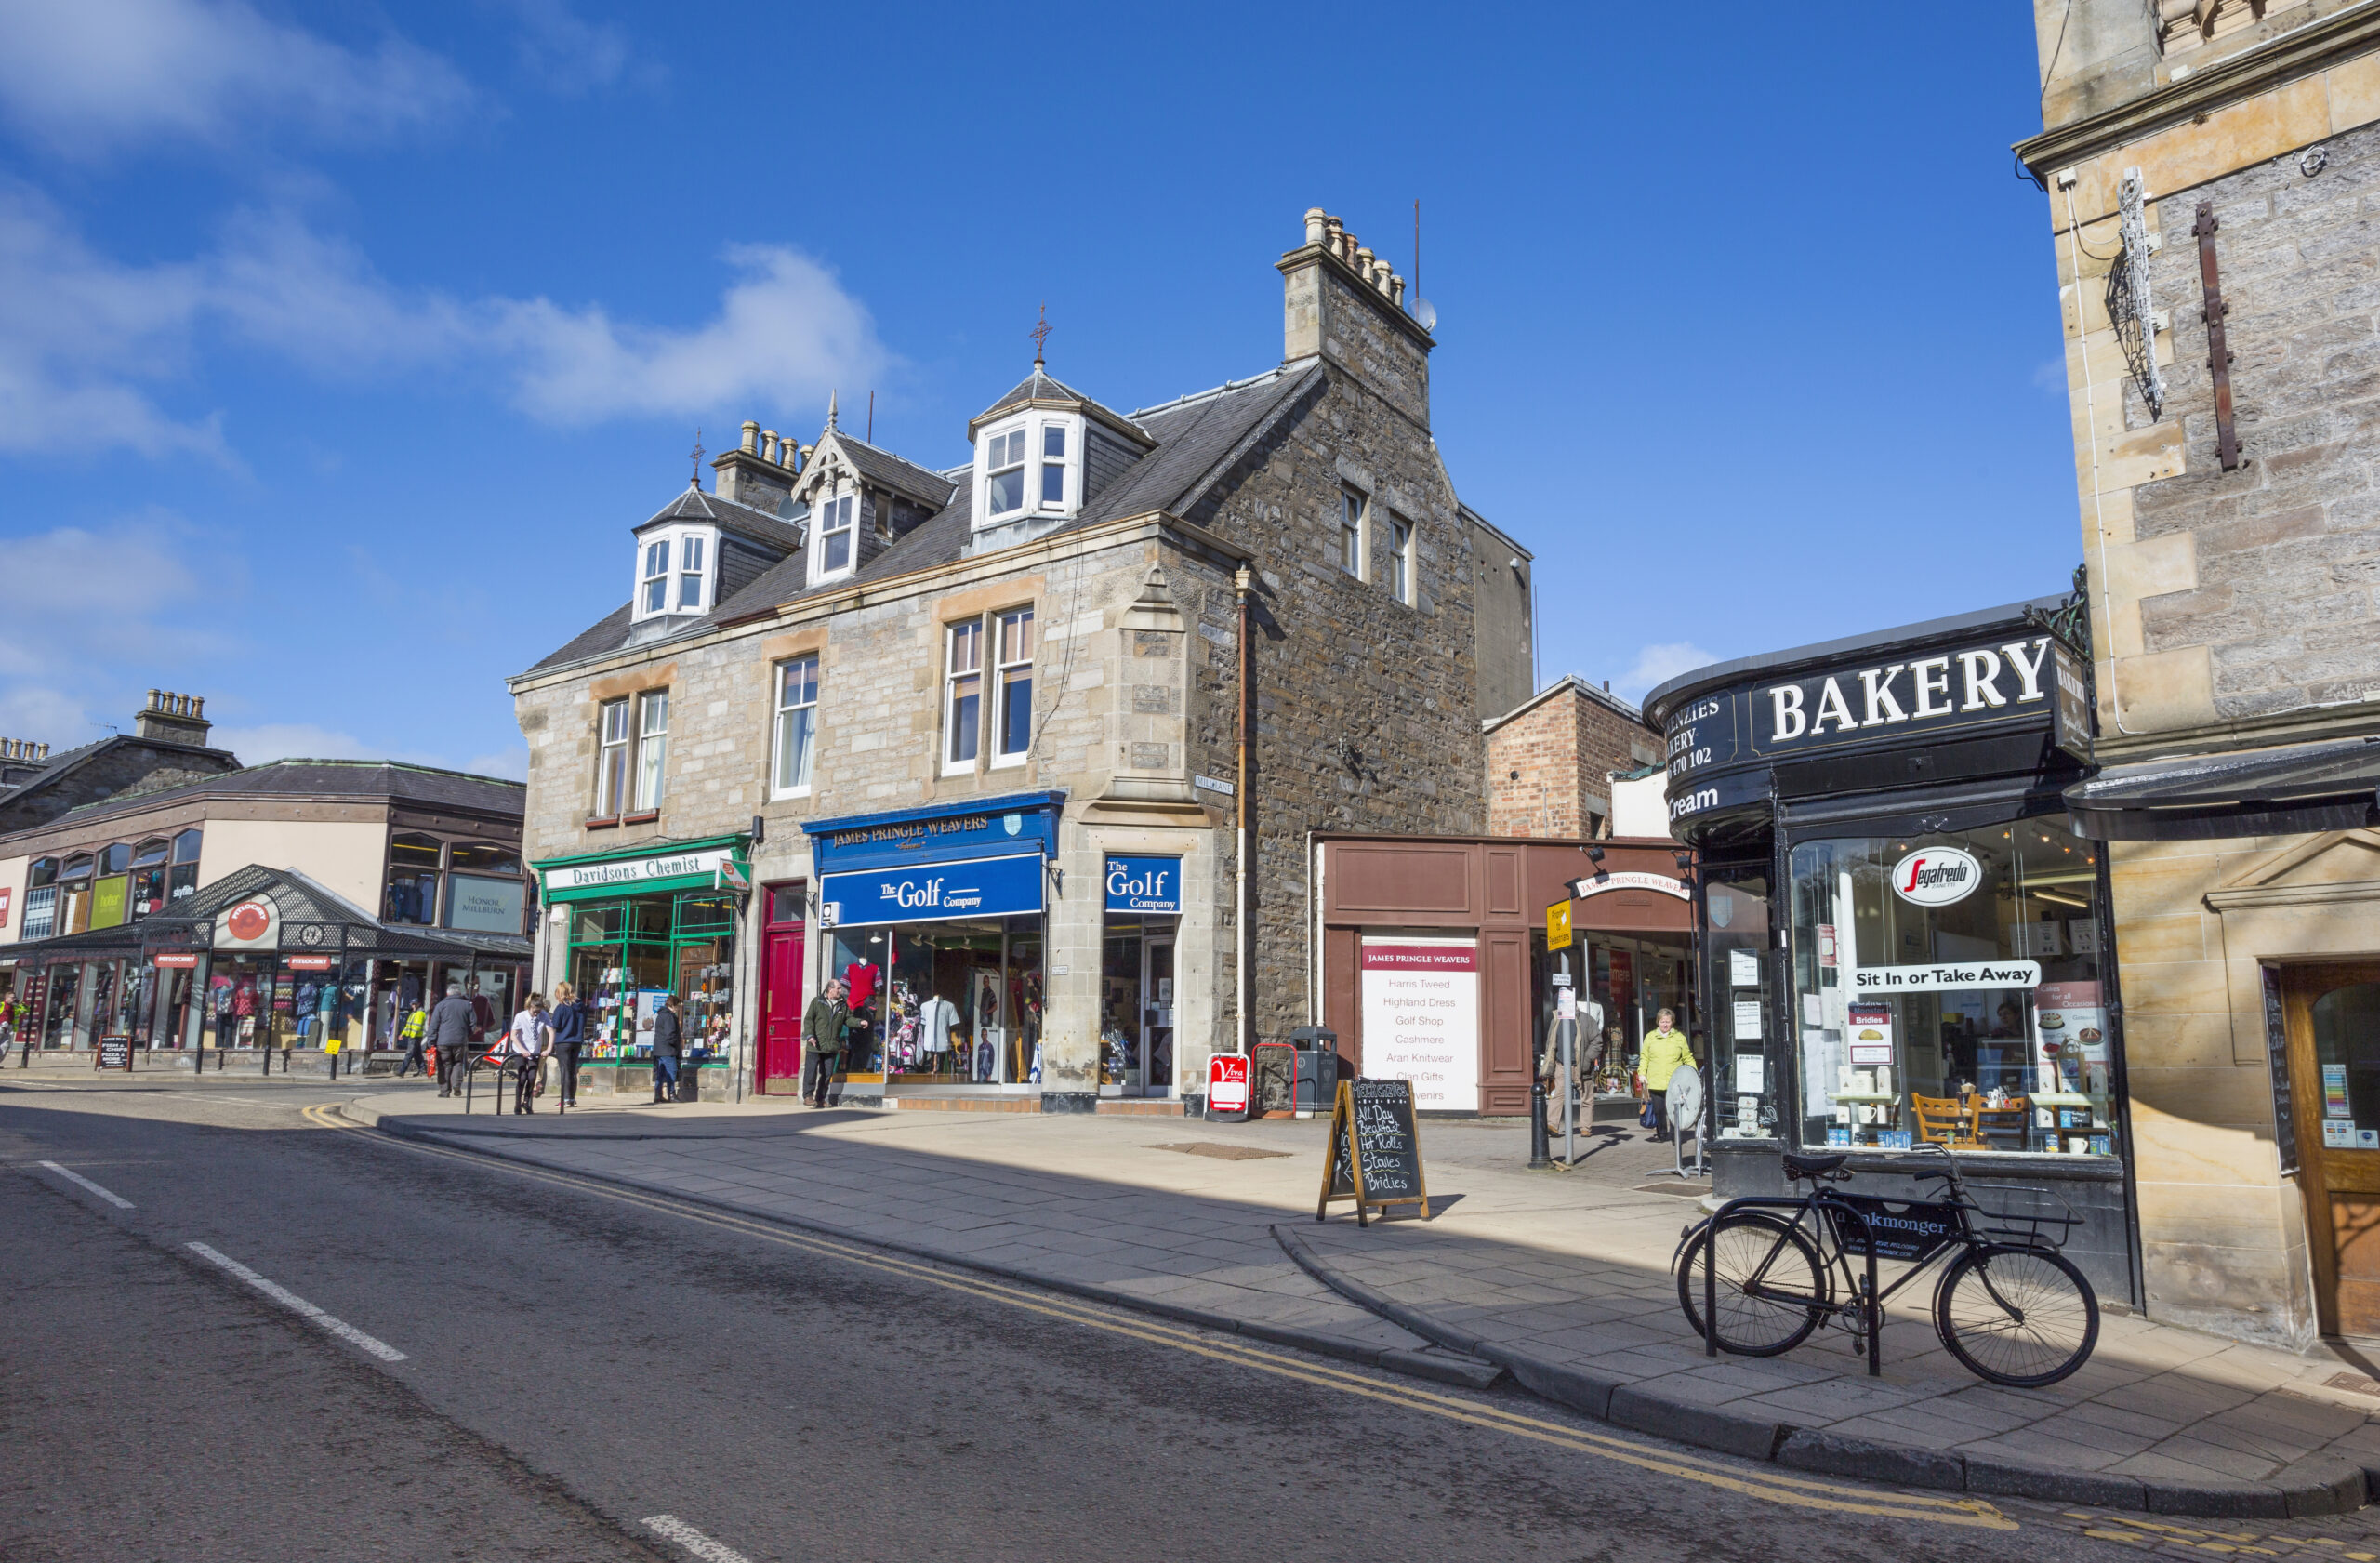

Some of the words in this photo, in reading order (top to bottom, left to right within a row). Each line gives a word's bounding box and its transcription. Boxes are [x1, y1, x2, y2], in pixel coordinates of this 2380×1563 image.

[1768, 637, 2053, 743] BAKERY
[1673, 755, 1687, 776] 470
[1690, 747, 1712, 768] 102
[1197, 776, 1213, 788] MILL
[1214, 781, 1232, 793] LANE
[1668, 788, 1719, 822] Cream
[833, 830, 869, 848] JAMES
[872, 824, 924, 841] PRINGLE
[927, 816, 989, 835] WEAVERS
[573, 866, 637, 885] Davidsons
[646, 856, 700, 877] Chemist
[1107, 860, 1128, 871] The
[1610, 876, 1649, 885] PRINGLE
[1904, 858, 1968, 893] Segafredo
[1106, 871, 1169, 897] Golf
[468, 895, 499, 907] HONOR
[881, 883, 896, 895] The
[897, 878, 945, 907] Golf
[943, 896, 982, 909] Company
[231, 903, 268, 921] PITLOCHRY
[462, 905, 507, 915] MILLBURN
[1130, 897, 1176, 911] Company
[1555, 922, 1561, 931] to
[1368, 954, 1394, 963] JAMES
[1395, 954, 1432, 964] PRINGLE
[1434, 955, 1470, 964] WEAVERS
[1389, 978, 1417, 988] Harris
[1420, 978, 1451, 989] Tweed
[1856, 973, 1881, 987] Sit
[1885, 972, 1903, 986] In
[1908, 974, 1929, 985] or
[1931, 969, 1976, 984] Take
[1979, 967, 2033, 984] Away
[1383, 998, 1426, 1009] Highland
[1428, 998, 1456, 1008] Dress
[1395, 1015, 1416, 1026] Golf
[1418, 1015, 1444, 1027] Shop
[1395, 1034, 1445, 1044] Cashmere
[1386, 1053, 1409, 1063] Aran
[1411, 1053, 1454, 1063] Knitwear
[1211, 1060, 1243, 1082] Viva
[1396, 1071, 1419, 1081] Clan
[1421, 1071, 1444, 1082] Gifts
[1413, 1090, 1445, 1101] venirs
[1357, 1106, 1373, 1121] All
[1372, 1105, 1395, 1124] Day
[1357, 1120, 1402, 1135] Breakfast
[1360, 1134, 1375, 1151] Hot
[1377, 1133, 1403, 1150] Rolls
[1365, 1173, 1408, 1191] Bridies
